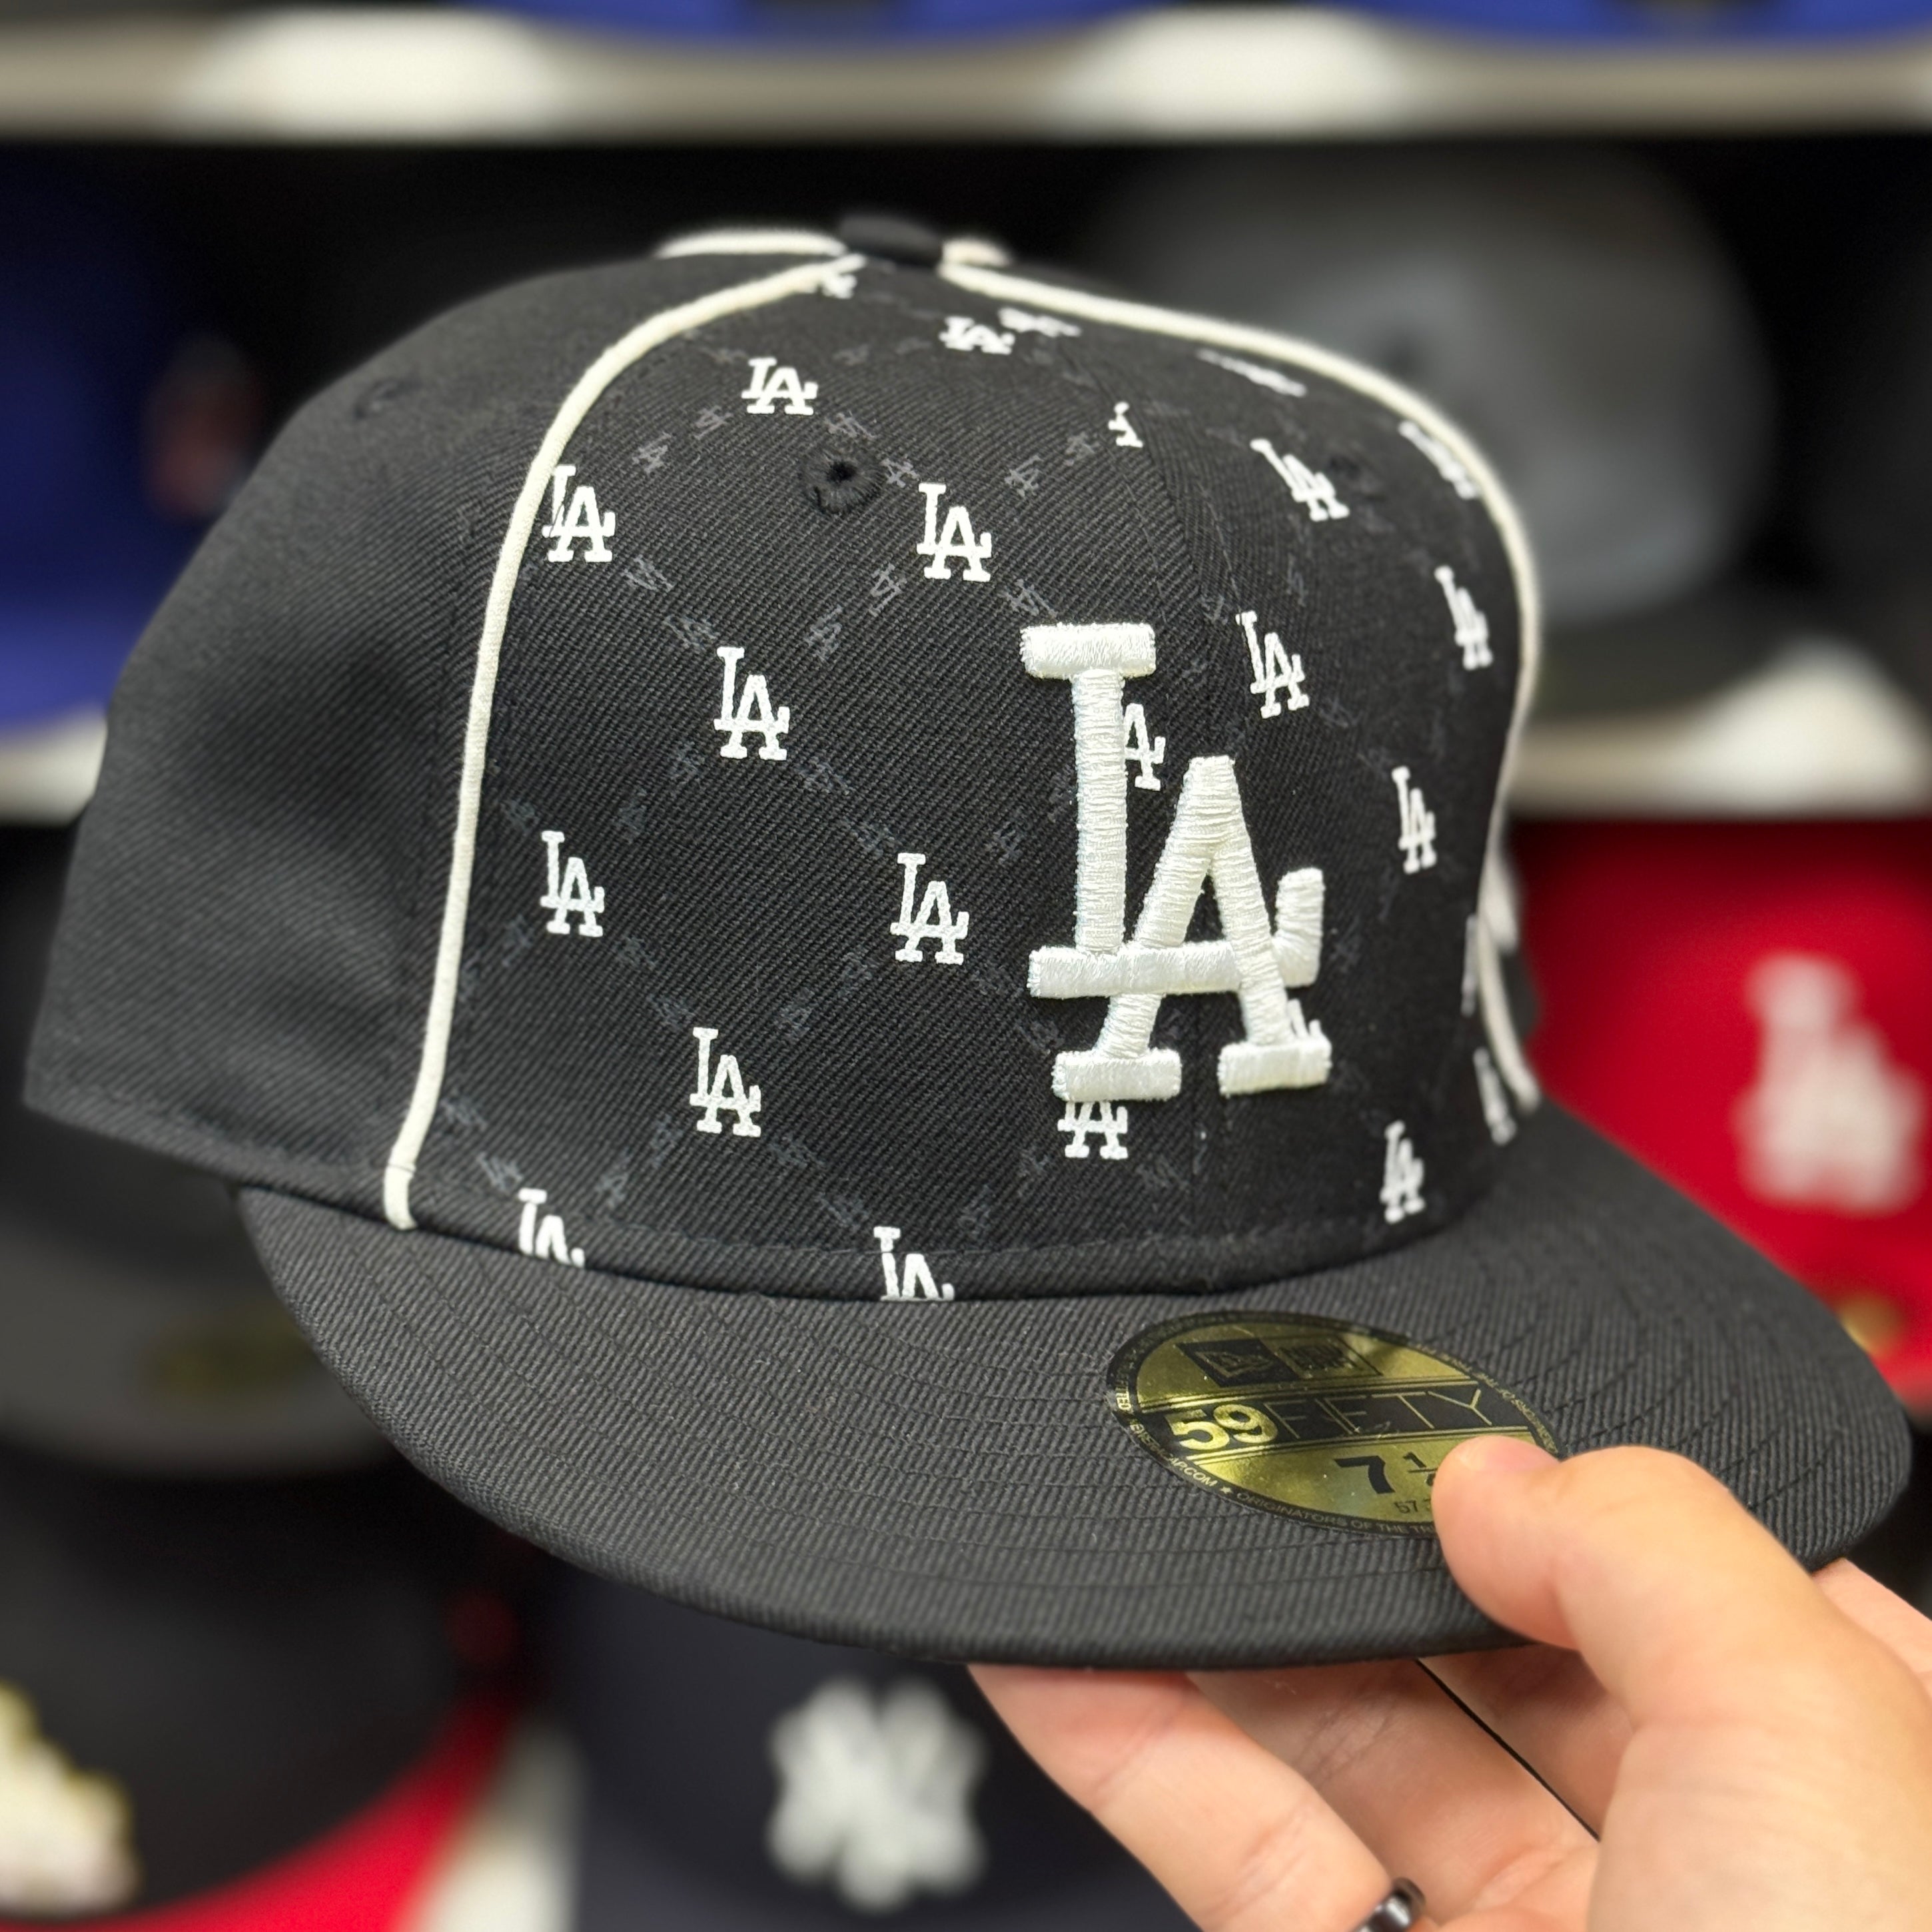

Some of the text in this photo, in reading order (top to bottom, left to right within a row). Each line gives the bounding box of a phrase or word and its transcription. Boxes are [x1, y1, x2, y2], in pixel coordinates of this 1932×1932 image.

[741, 356, 819, 415] LA
[542, 465, 616, 562] LA
[916, 482, 992, 582] LA
[1250, 438, 1350, 522] LA
[1235, 610, 1309, 718] LA
[1434, 566, 1492, 670] LA
[714, 646, 790, 760] LA
[1125, 703, 1166, 791] A
[1020, 622, 1332, 1103] LA
[1392, 766, 1436, 873] LA
[540, 830, 605, 937] LA
[890, 852, 969, 965] LA
[690, 1027, 761, 1137] LA
[1381, 1122, 1424, 1222] LA
[1334, 1455, 1396, 1494] 7
